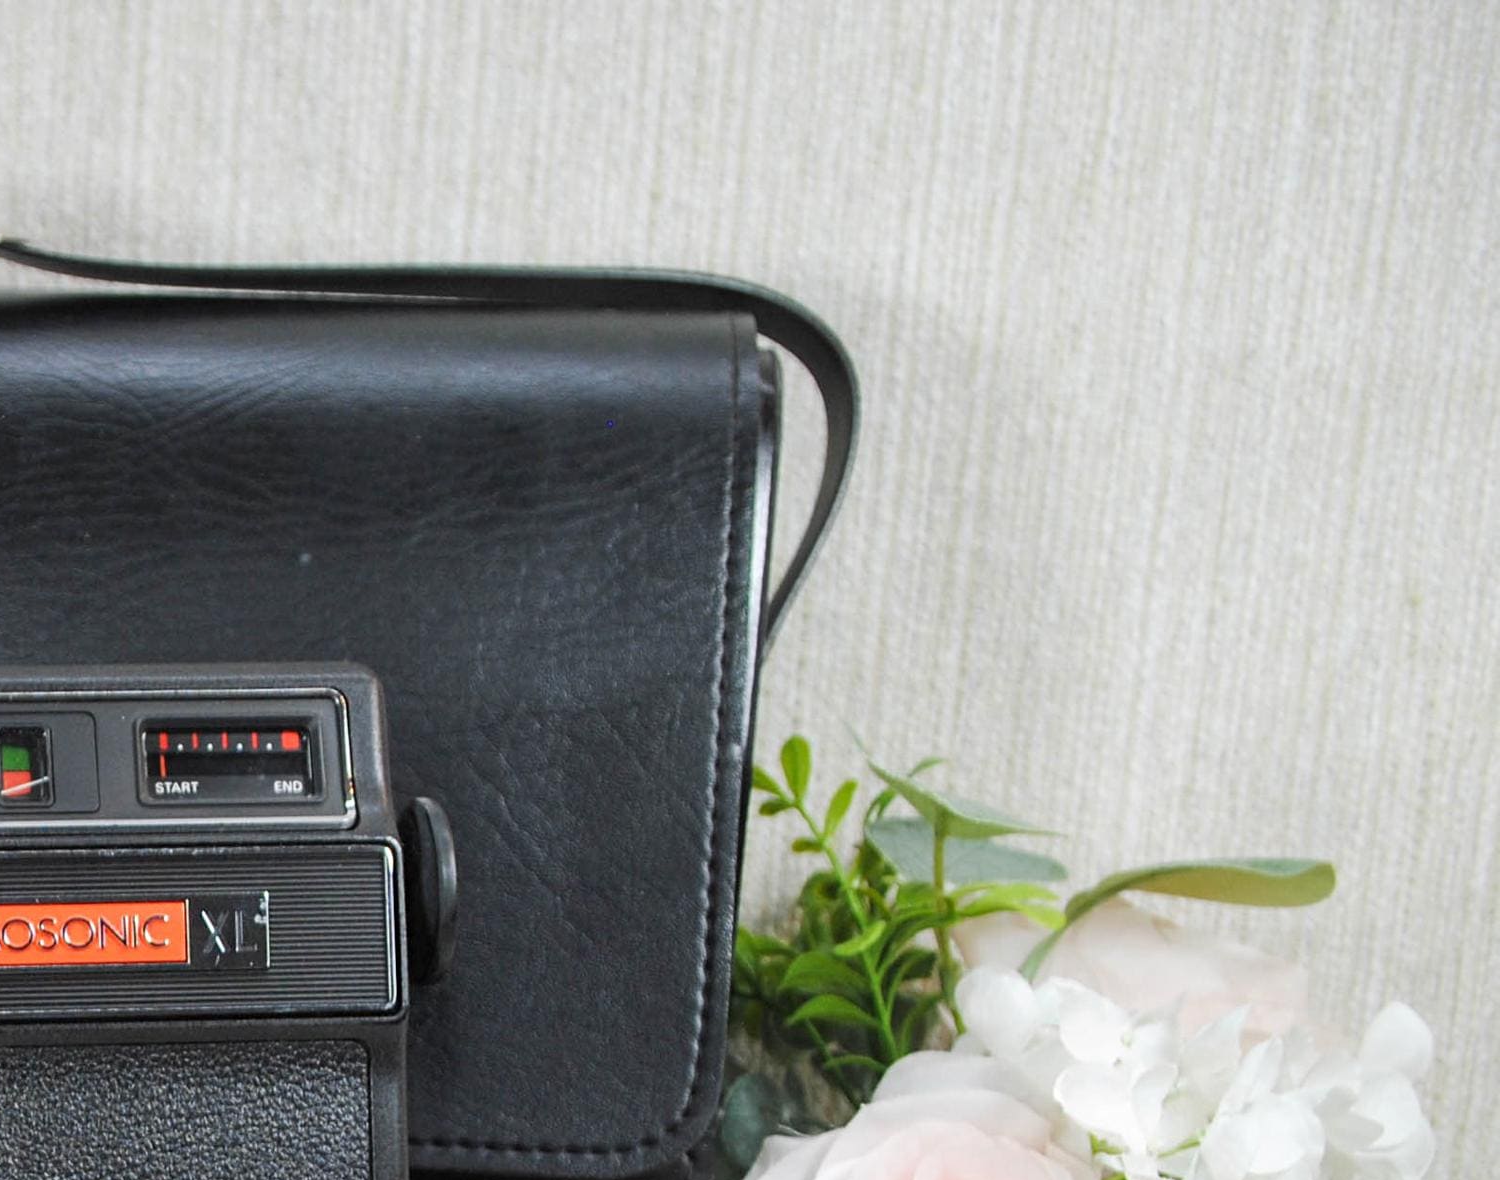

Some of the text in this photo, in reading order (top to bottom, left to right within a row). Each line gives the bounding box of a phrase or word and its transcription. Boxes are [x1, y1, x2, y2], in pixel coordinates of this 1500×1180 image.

[155, 781, 199, 794] START
[274, 780, 303, 793] END
[201, 909, 258, 954] XL
